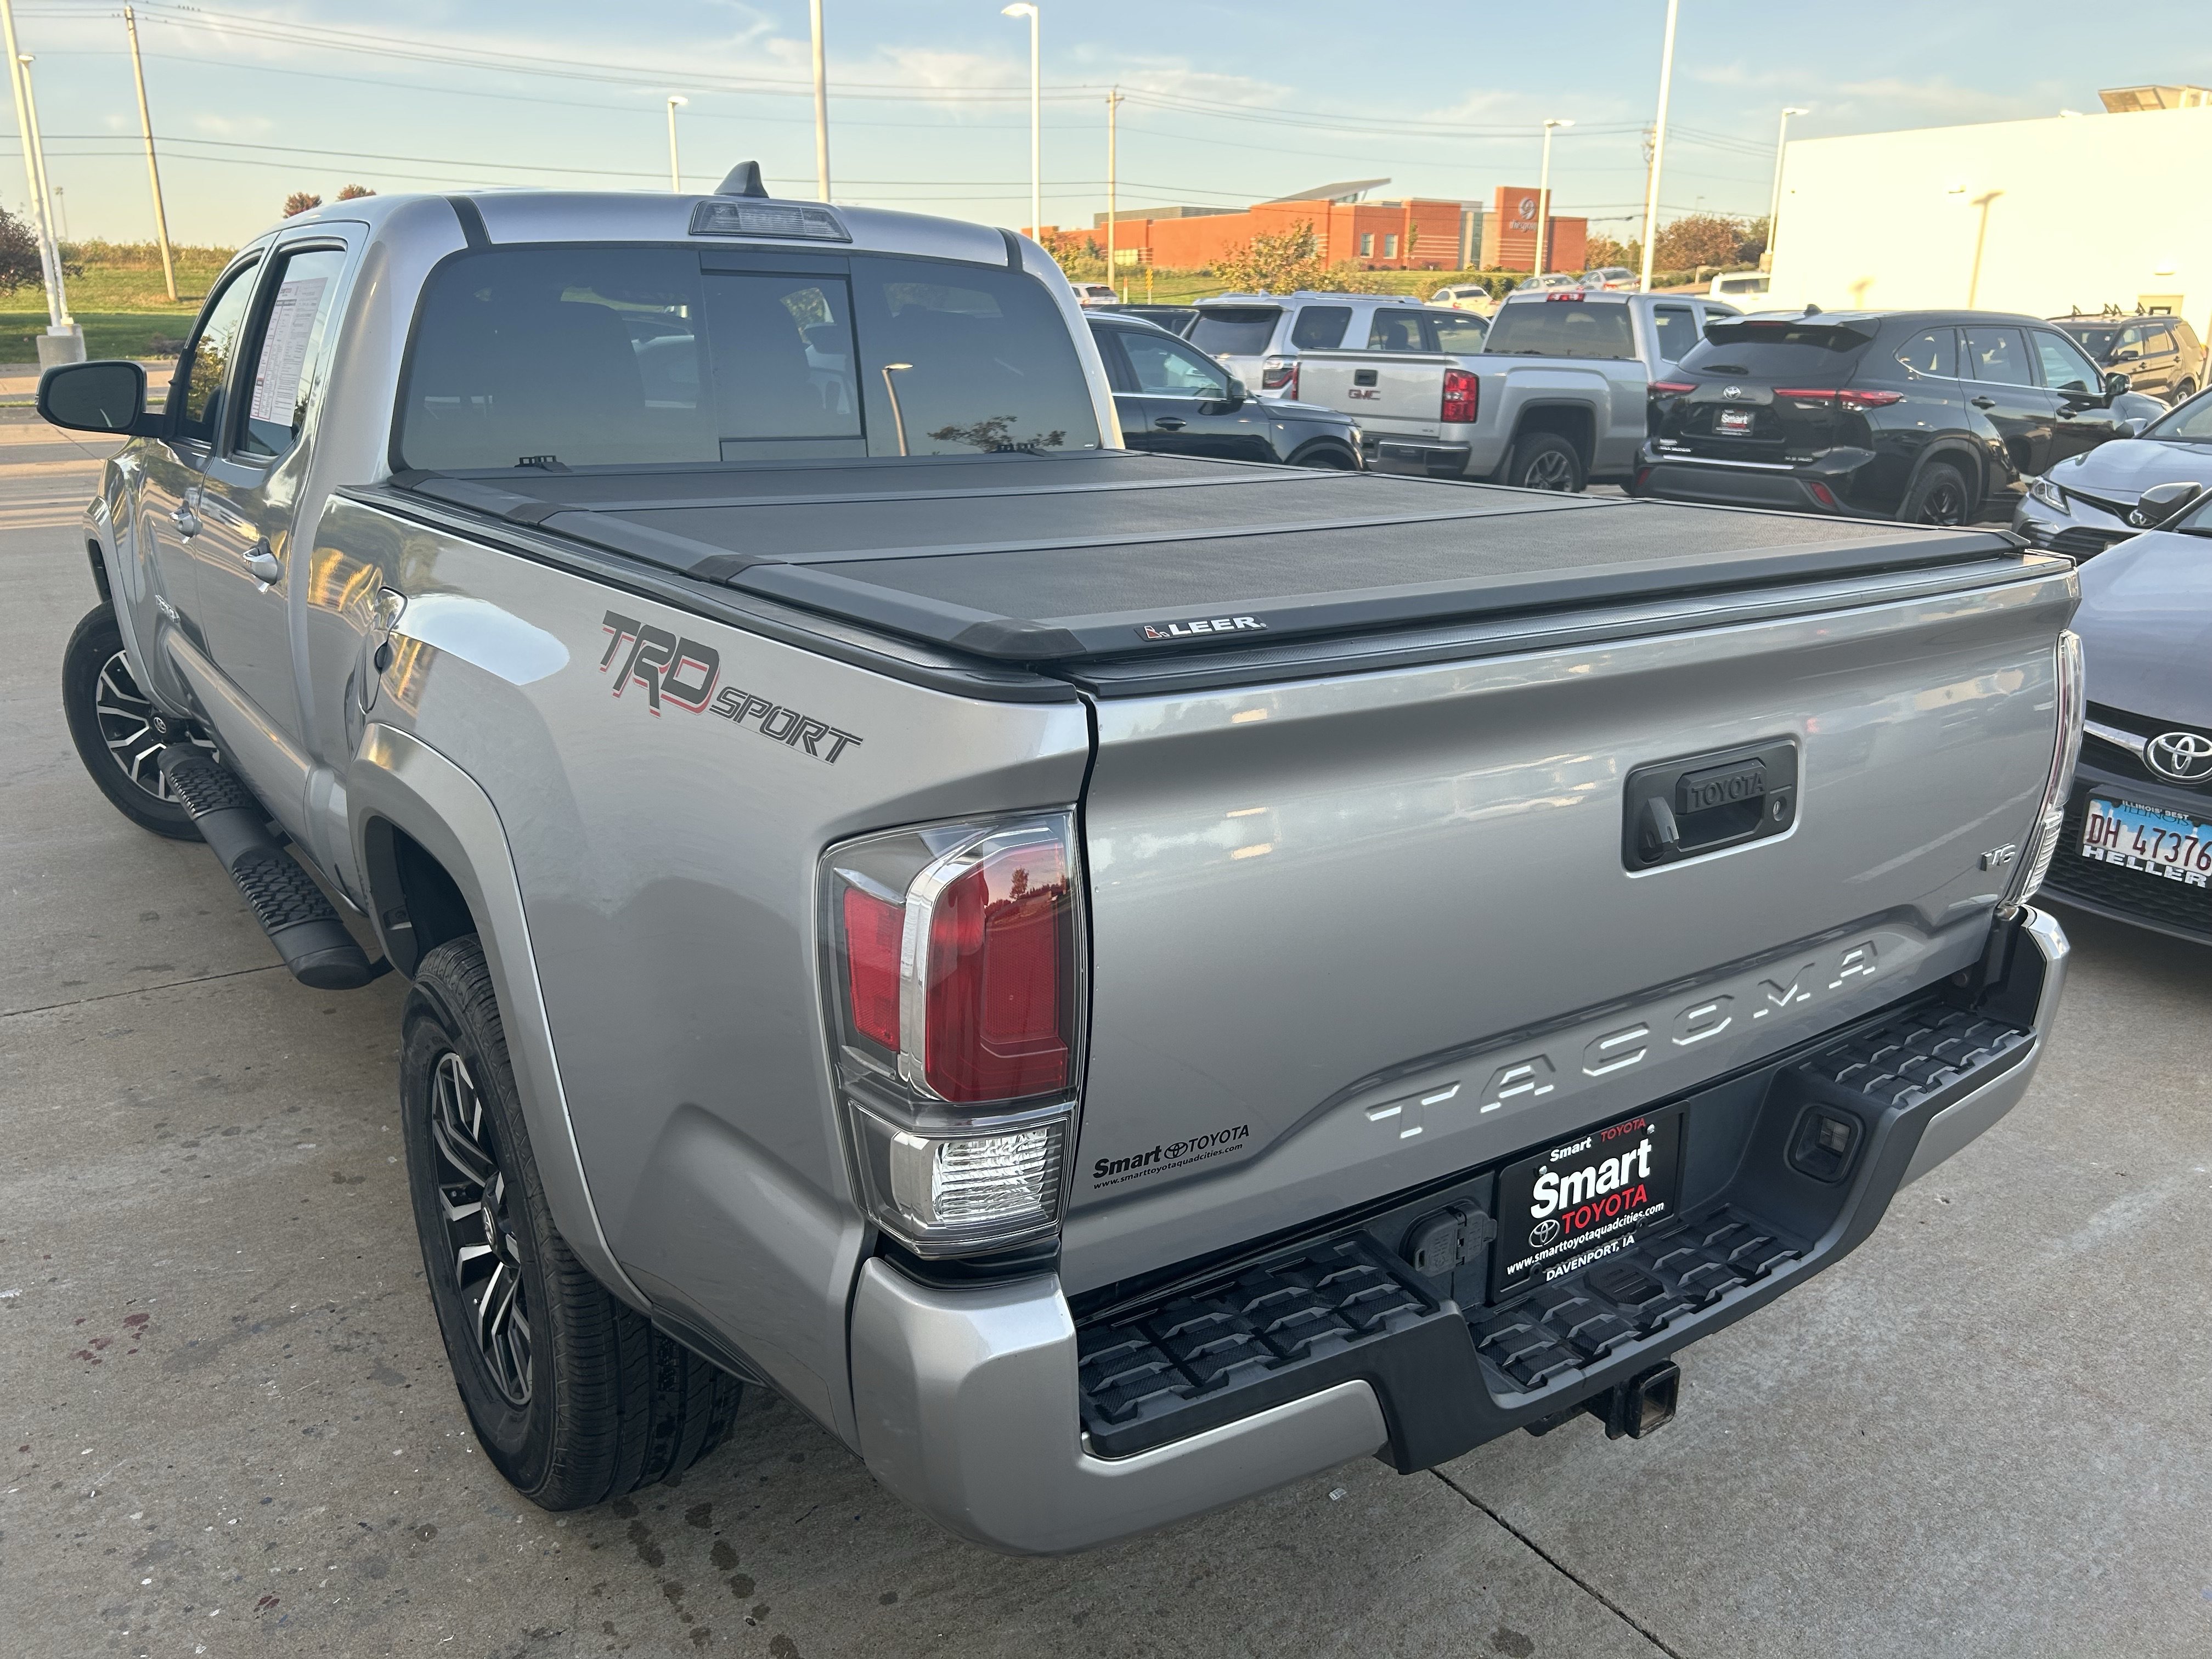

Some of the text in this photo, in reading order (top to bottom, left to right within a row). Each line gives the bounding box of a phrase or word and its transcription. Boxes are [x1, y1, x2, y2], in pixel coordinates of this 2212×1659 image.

[1349, 389, 1381, 401] GMC
[600, 610, 863, 765] TRD SPORT
[1692, 771, 1765, 808] TOYOTA
[2165, 810, 2189, 820] BEST
[2086, 813, 2212, 871] DH 47376
[2082, 845, 2207, 888] HELLER
[1364, 939, 1878, 1139] TACOMA
[1093, 1125, 1249, 1178] Smart TOYOTA
[1550, 1118, 1646, 1162] Smart TOYOTA
[1093, 1143, 1243, 1189] www.smarttoyotaquadcities.com
[1531, 1138, 1652, 1218] Smart
[1562, 1184, 1647, 1234] TOYOTA
[1507, 1202, 1664, 1275] www.smarttoyotaquadcities.com
[1546, 1234, 1635, 1281] DAVENPORT, IA
